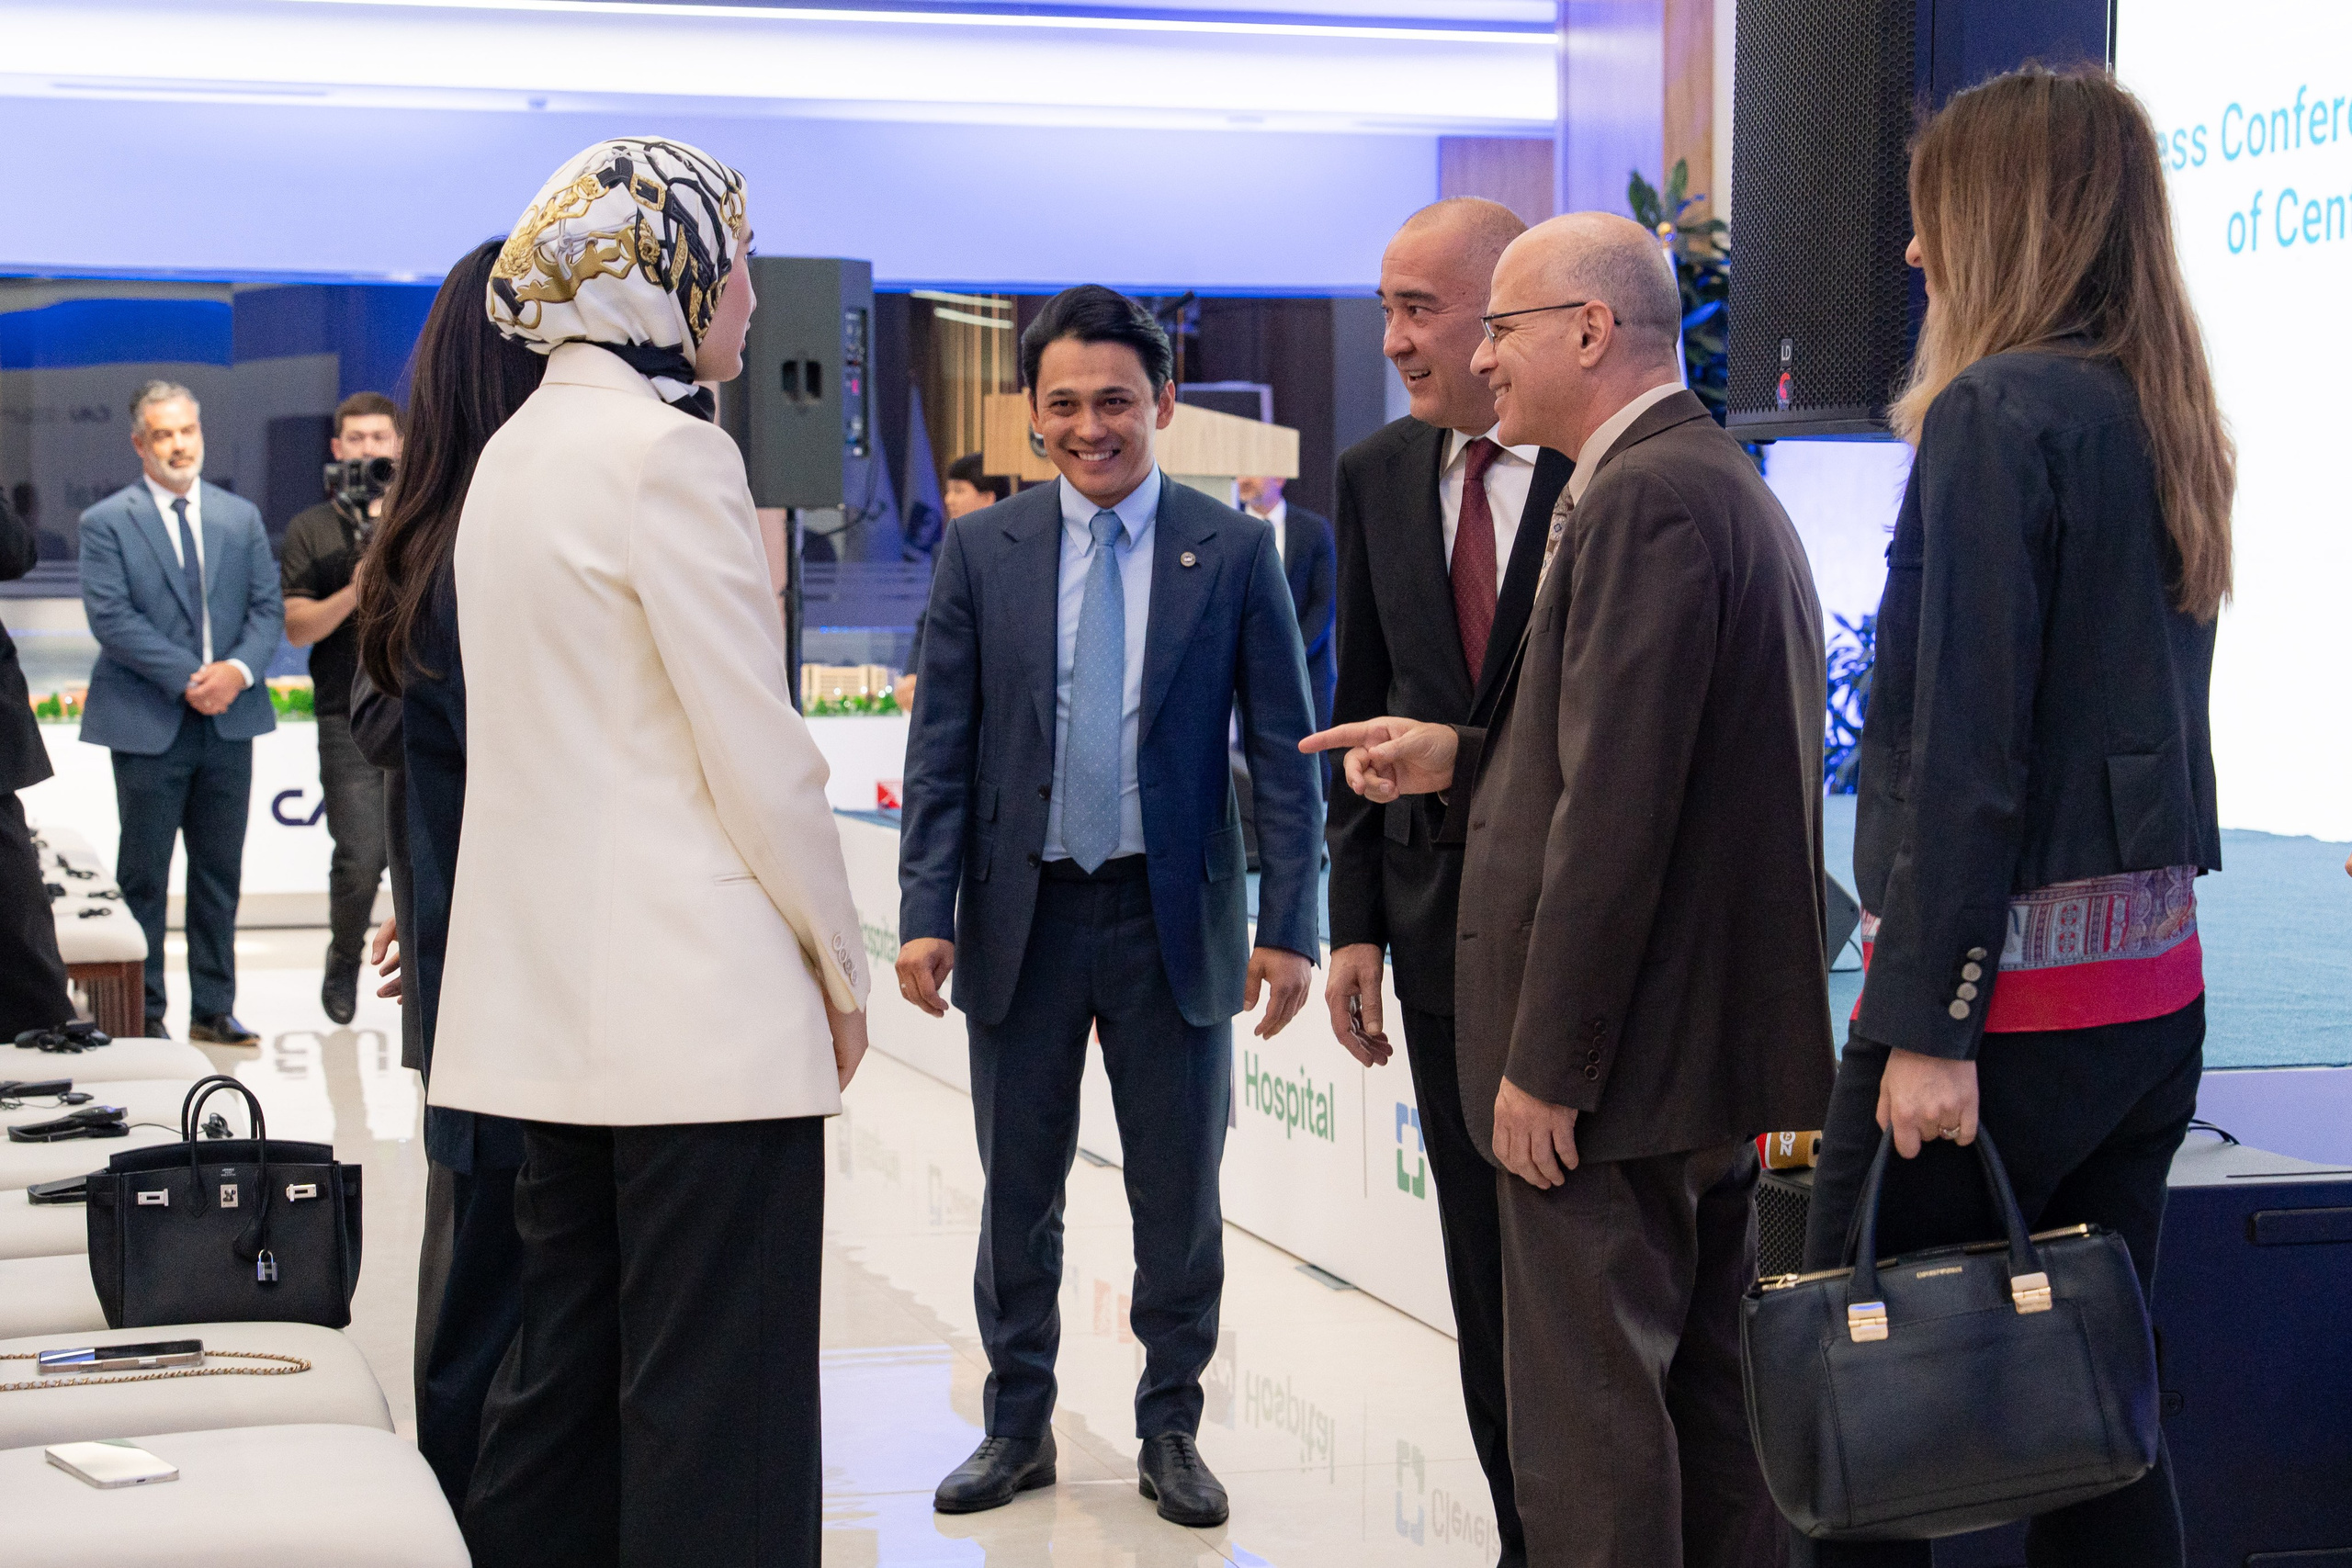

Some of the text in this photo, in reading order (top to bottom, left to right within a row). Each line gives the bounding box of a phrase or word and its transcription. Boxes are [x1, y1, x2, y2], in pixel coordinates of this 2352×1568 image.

[2222, 84, 2352, 162] Confer
[2227, 187, 2352, 255] of Cen
[1244, 1050, 1334, 1144] Hospital
